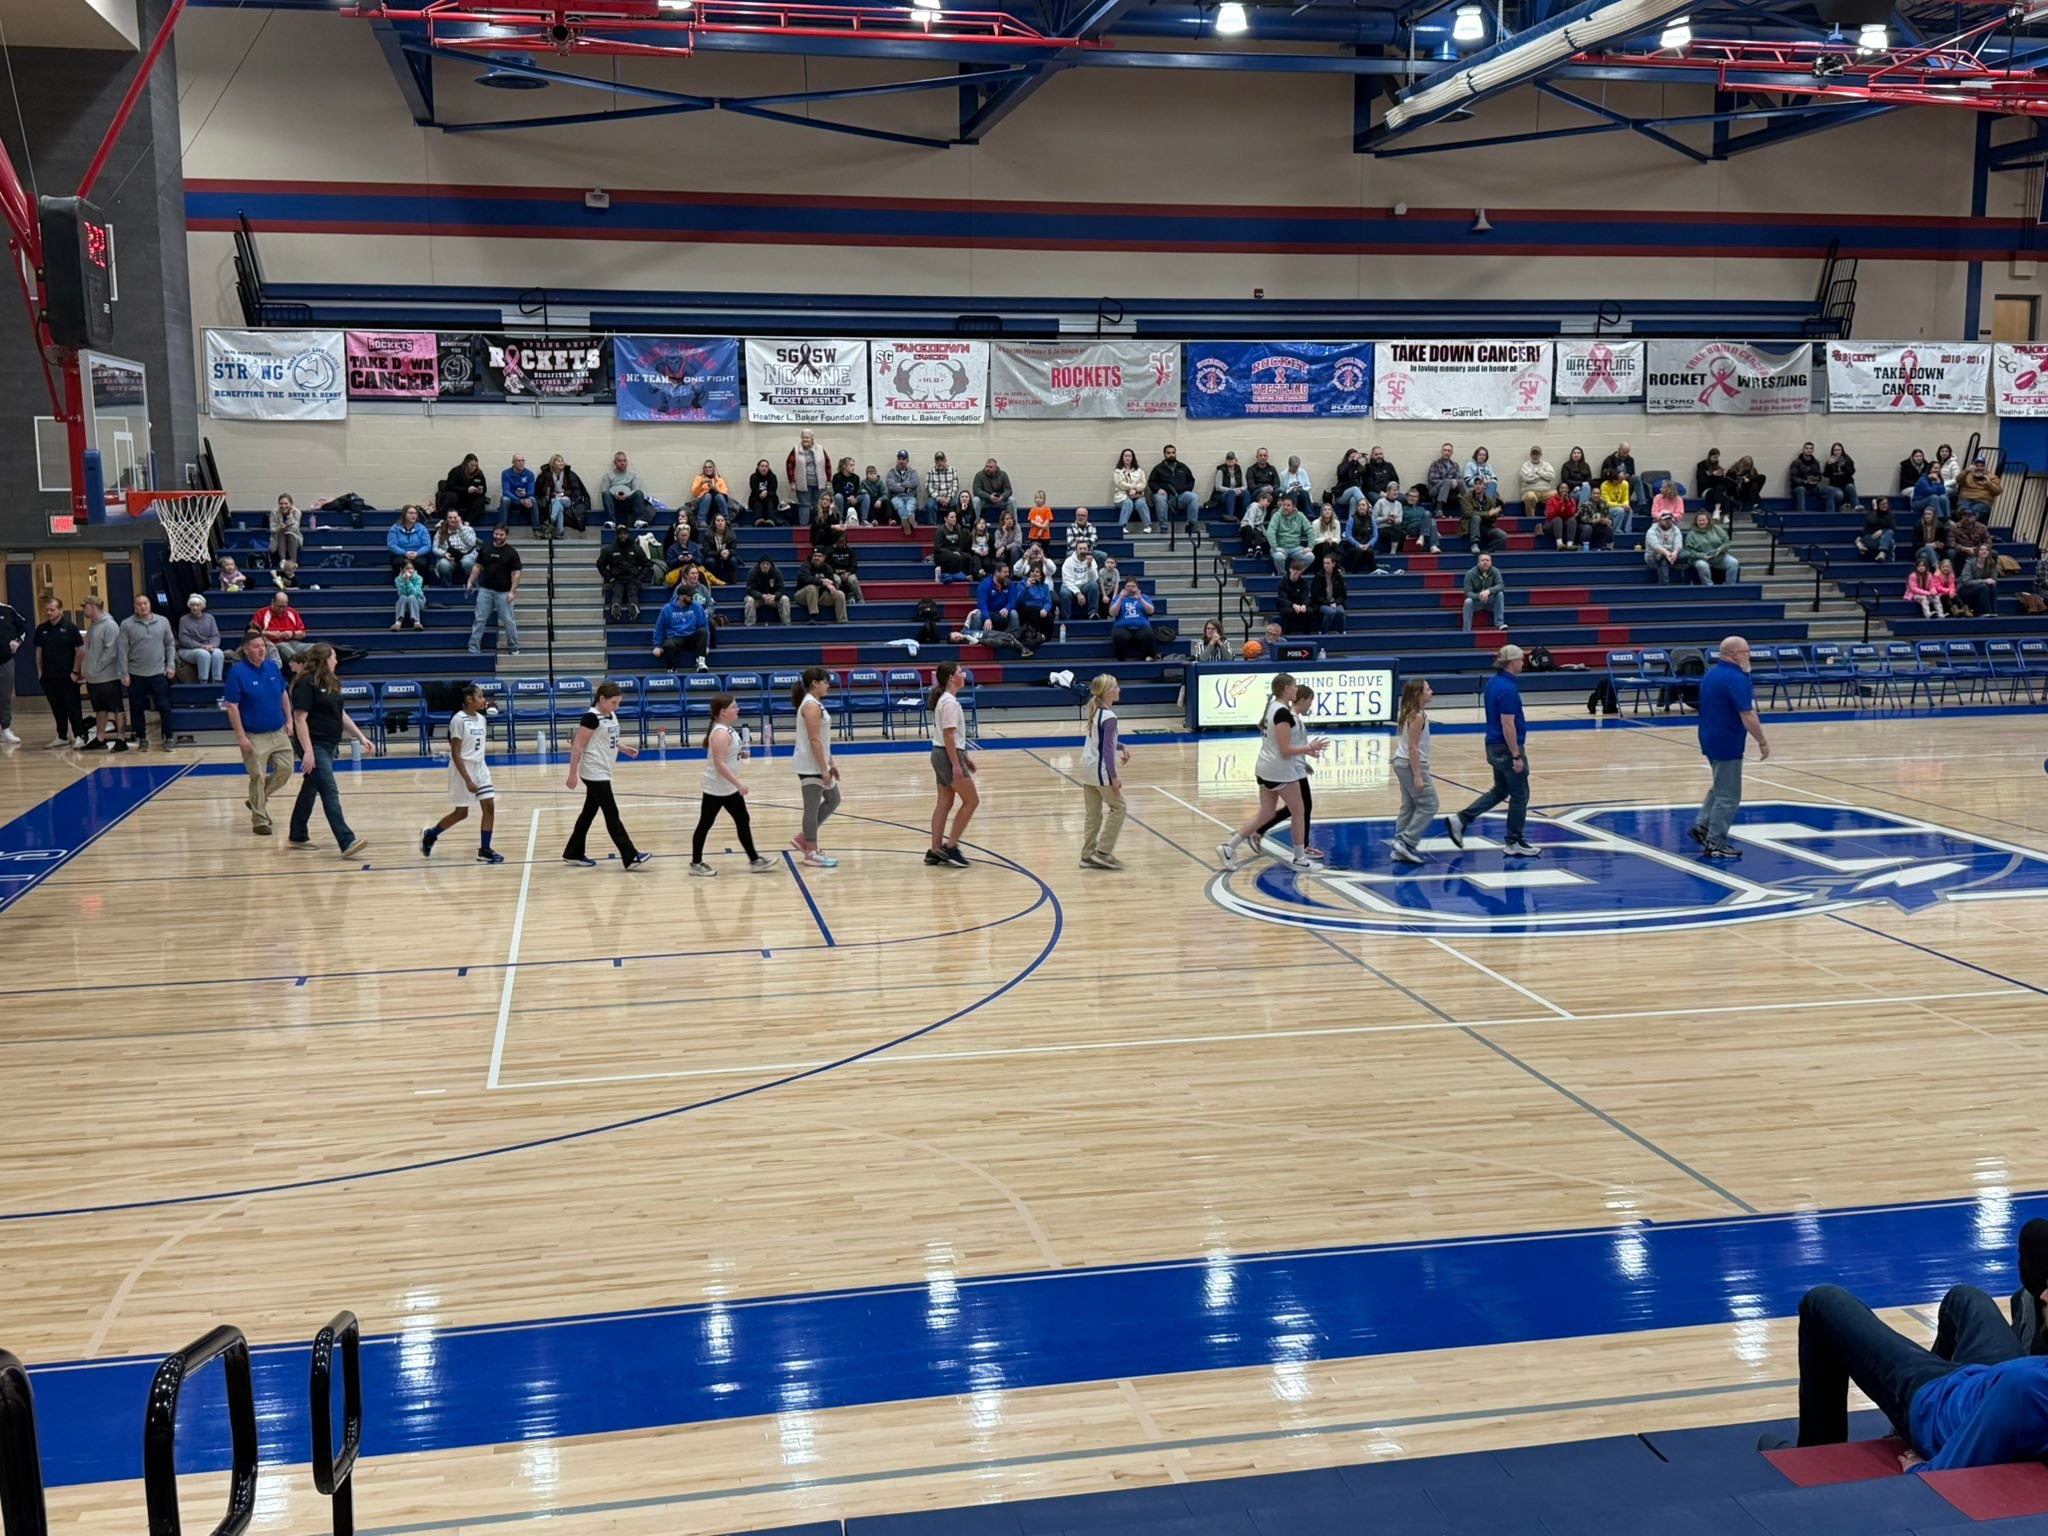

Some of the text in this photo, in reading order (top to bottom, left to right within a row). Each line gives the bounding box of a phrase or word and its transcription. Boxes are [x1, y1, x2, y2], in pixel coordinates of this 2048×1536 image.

[368, 338, 414, 352] ROCKETS
[776, 348, 838, 364] SG SW
[876, 350, 894, 363] SG
[1391, 344, 1540, 362] TAKE DOWN CANCER!
[1940, 354, 1961, 364] 2010
[1966, 355, 1985, 364] 2011
[350, 356, 388, 368] TAKE
[1149, 352, 1174, 372] SG
[1252, 356, 1310, 374] ROCKET
[1566, 358, 1636, 371] WRESTLING
[764, 364, 852, 386] NO ONE
[1410, 364, 1418, 372] In
[1418, 364, 1438, 373] loving
[1440, 366, 1466, 374] memory
[1481, 364, 1488, 372] in
[1488, 364, 1508, 372] honor
[1874, 367, 1944, 380] TAKE DOWN
[350, 370, 435, 390] CANCER
[642, 374, 670, 384] TEAM
[1051, 366, 1122, 388] ROCKETS
[1649, 372, 1808, 389] ROCKET WRESTLING
[214, 390, 264, 398] BENEFITING
[812, 388, 841, 396] ALONE
[1252, 384, 1309, 394] WRESTLING
[1388, 380, 1406, 395] SG
[1519, 380, 1540, 396] SW
[994, 396, 1042, 408] SG WRESTLING
[648, 678, 674, 686] ROCKETS
[690, 678, 715, 686] ROCKETS
[892, 672, 915, 680] ROCKETS
[1296, 674, 1383, 688] PRING GROVE
[518, 682, 544, 690] ROCKETS
[559, 681, 585, 689] ROCKETS
[475, 738, 481, 750] 2
